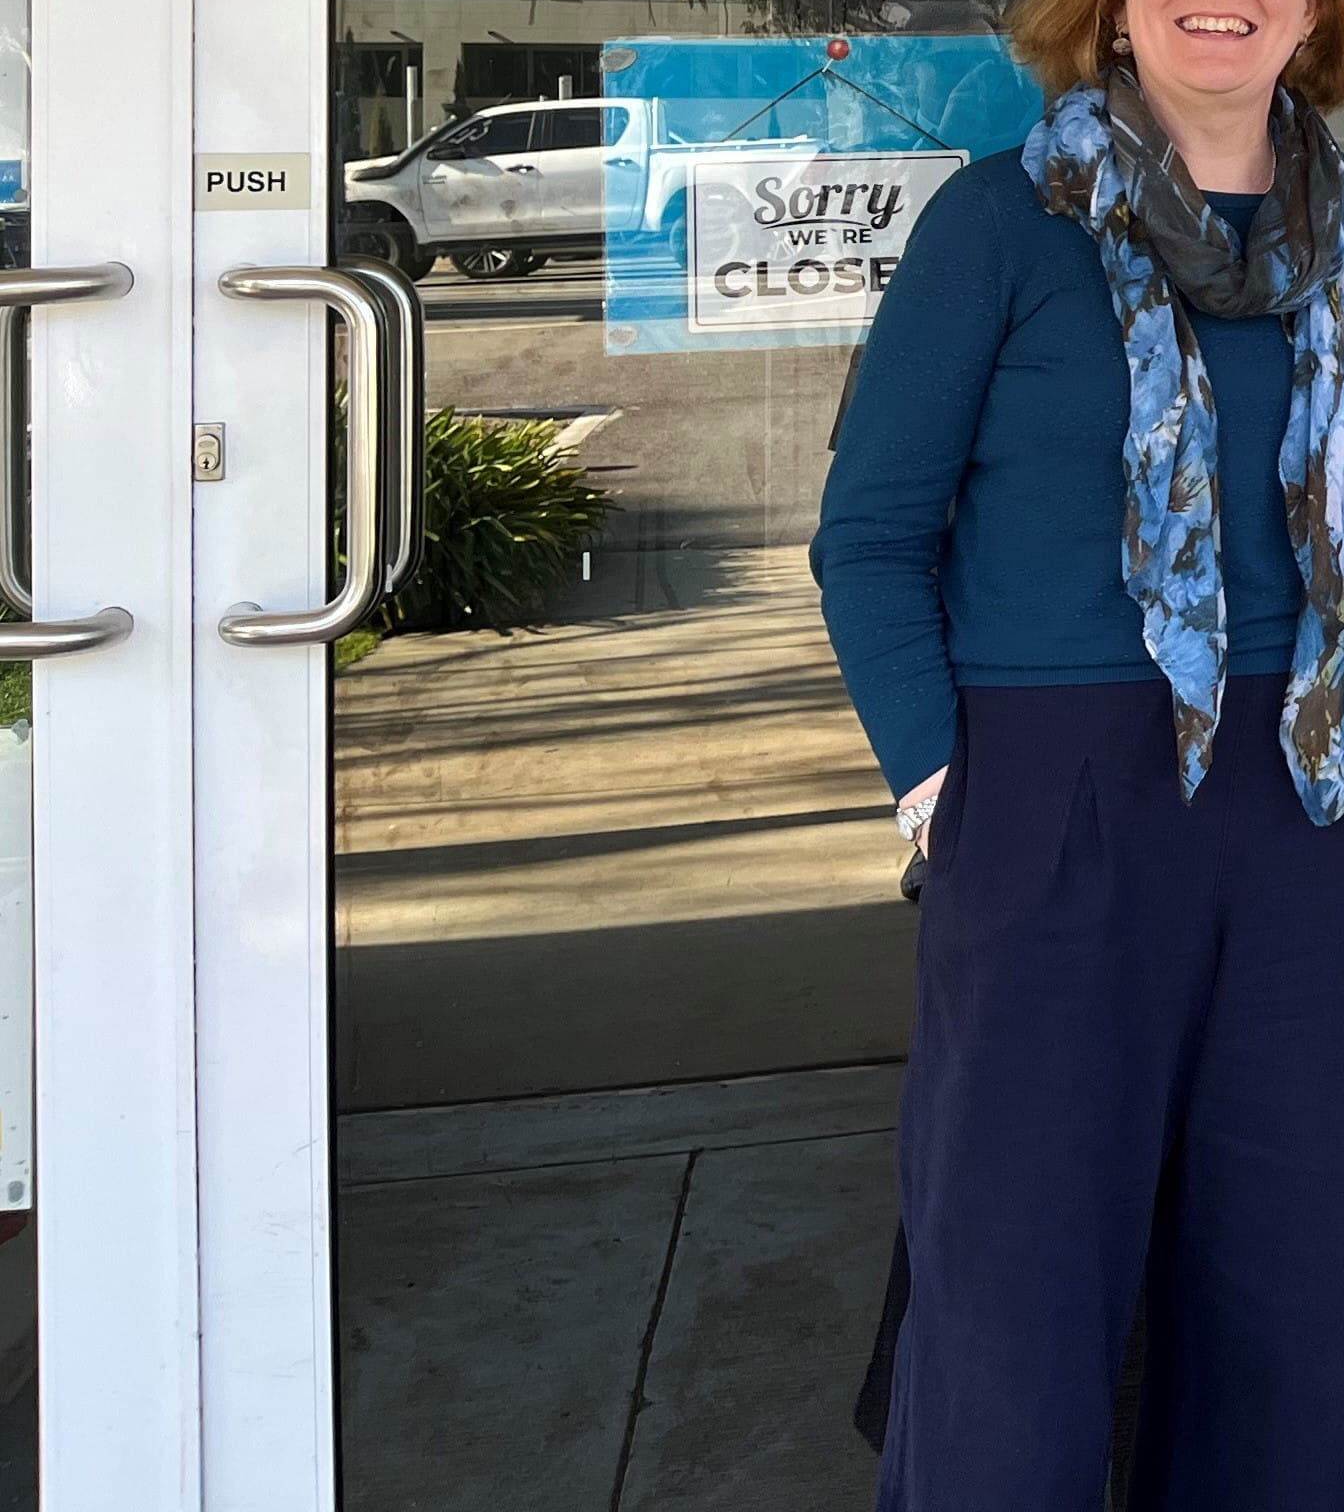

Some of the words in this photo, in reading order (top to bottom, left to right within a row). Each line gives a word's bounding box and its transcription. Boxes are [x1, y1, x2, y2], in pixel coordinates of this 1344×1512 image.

[207, 171, 286, 192] PUSH
[754, 177, 904, 230] Sorry
[714, 256, 900, 298] CLOSE
